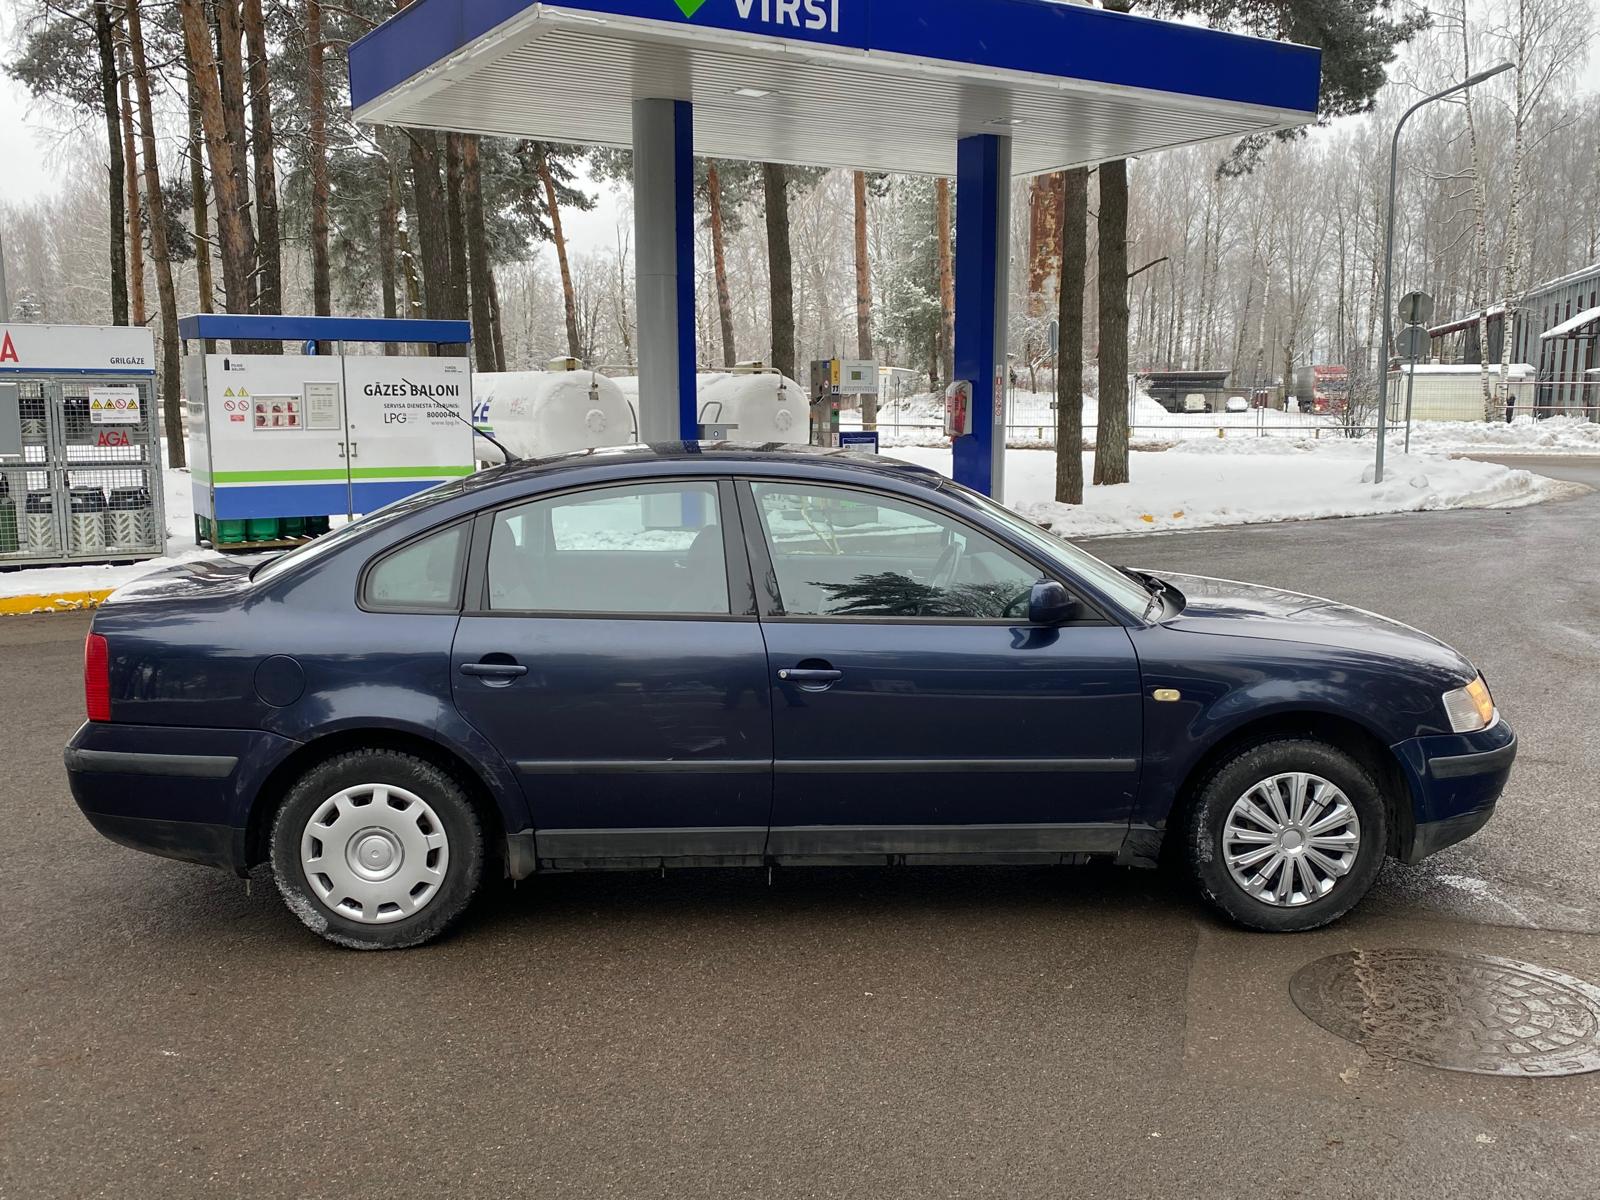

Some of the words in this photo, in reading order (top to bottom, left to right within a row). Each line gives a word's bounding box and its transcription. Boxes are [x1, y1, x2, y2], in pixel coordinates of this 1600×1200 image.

[110, 357, 145, 365] GRILGĀZE
[363, 382, 407, 397] GĀZES
[410, 384, 459, 397] BALONI
[384, 412, 407, 424] LPG
[97, 430, 130, 447] AGA
